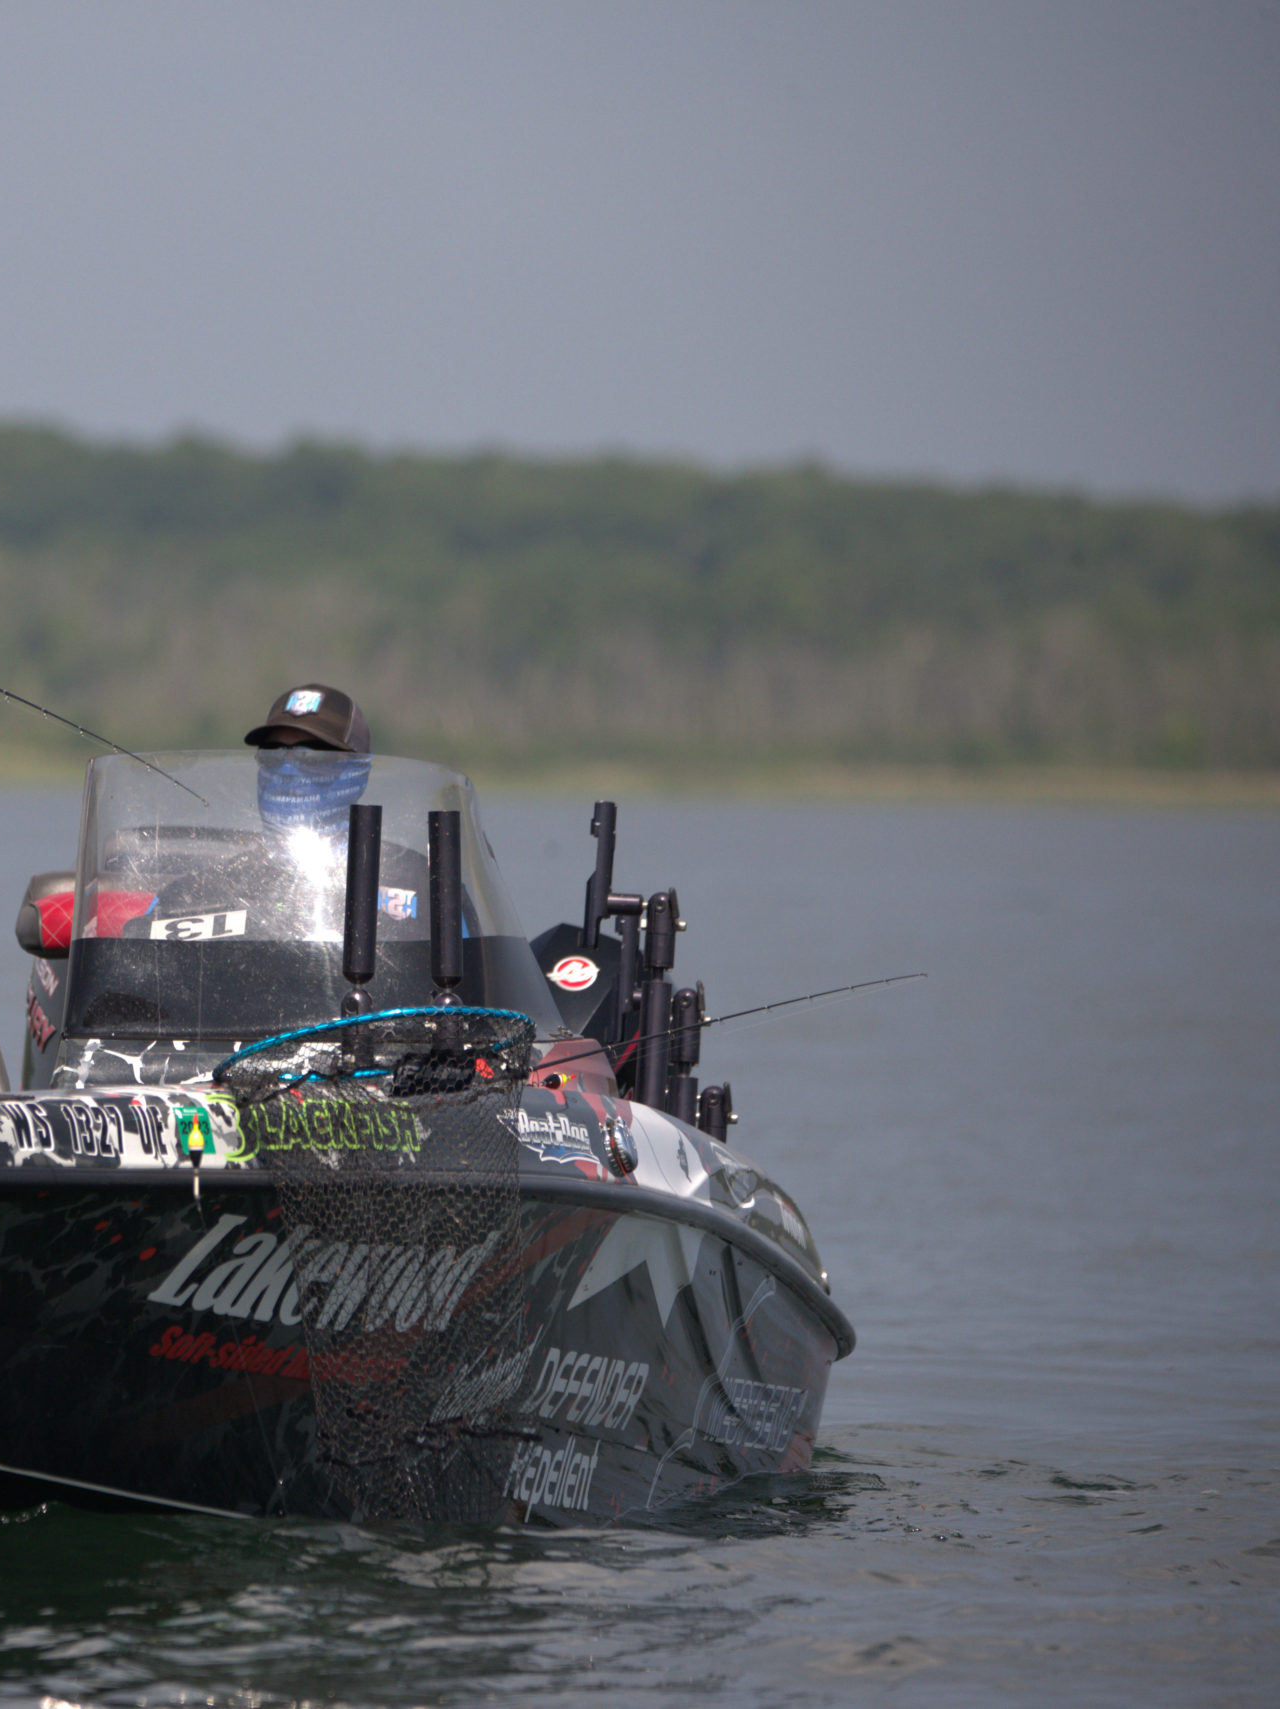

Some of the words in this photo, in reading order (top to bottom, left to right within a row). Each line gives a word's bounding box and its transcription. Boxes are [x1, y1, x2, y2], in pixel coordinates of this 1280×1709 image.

[0, 1101, 55, 1152] WS
[61, 1104, 125, 1158] 1327
[147, 1213, 502, 1333] Lakewood
[518, 1347, 649, 1431] DEFENDER
